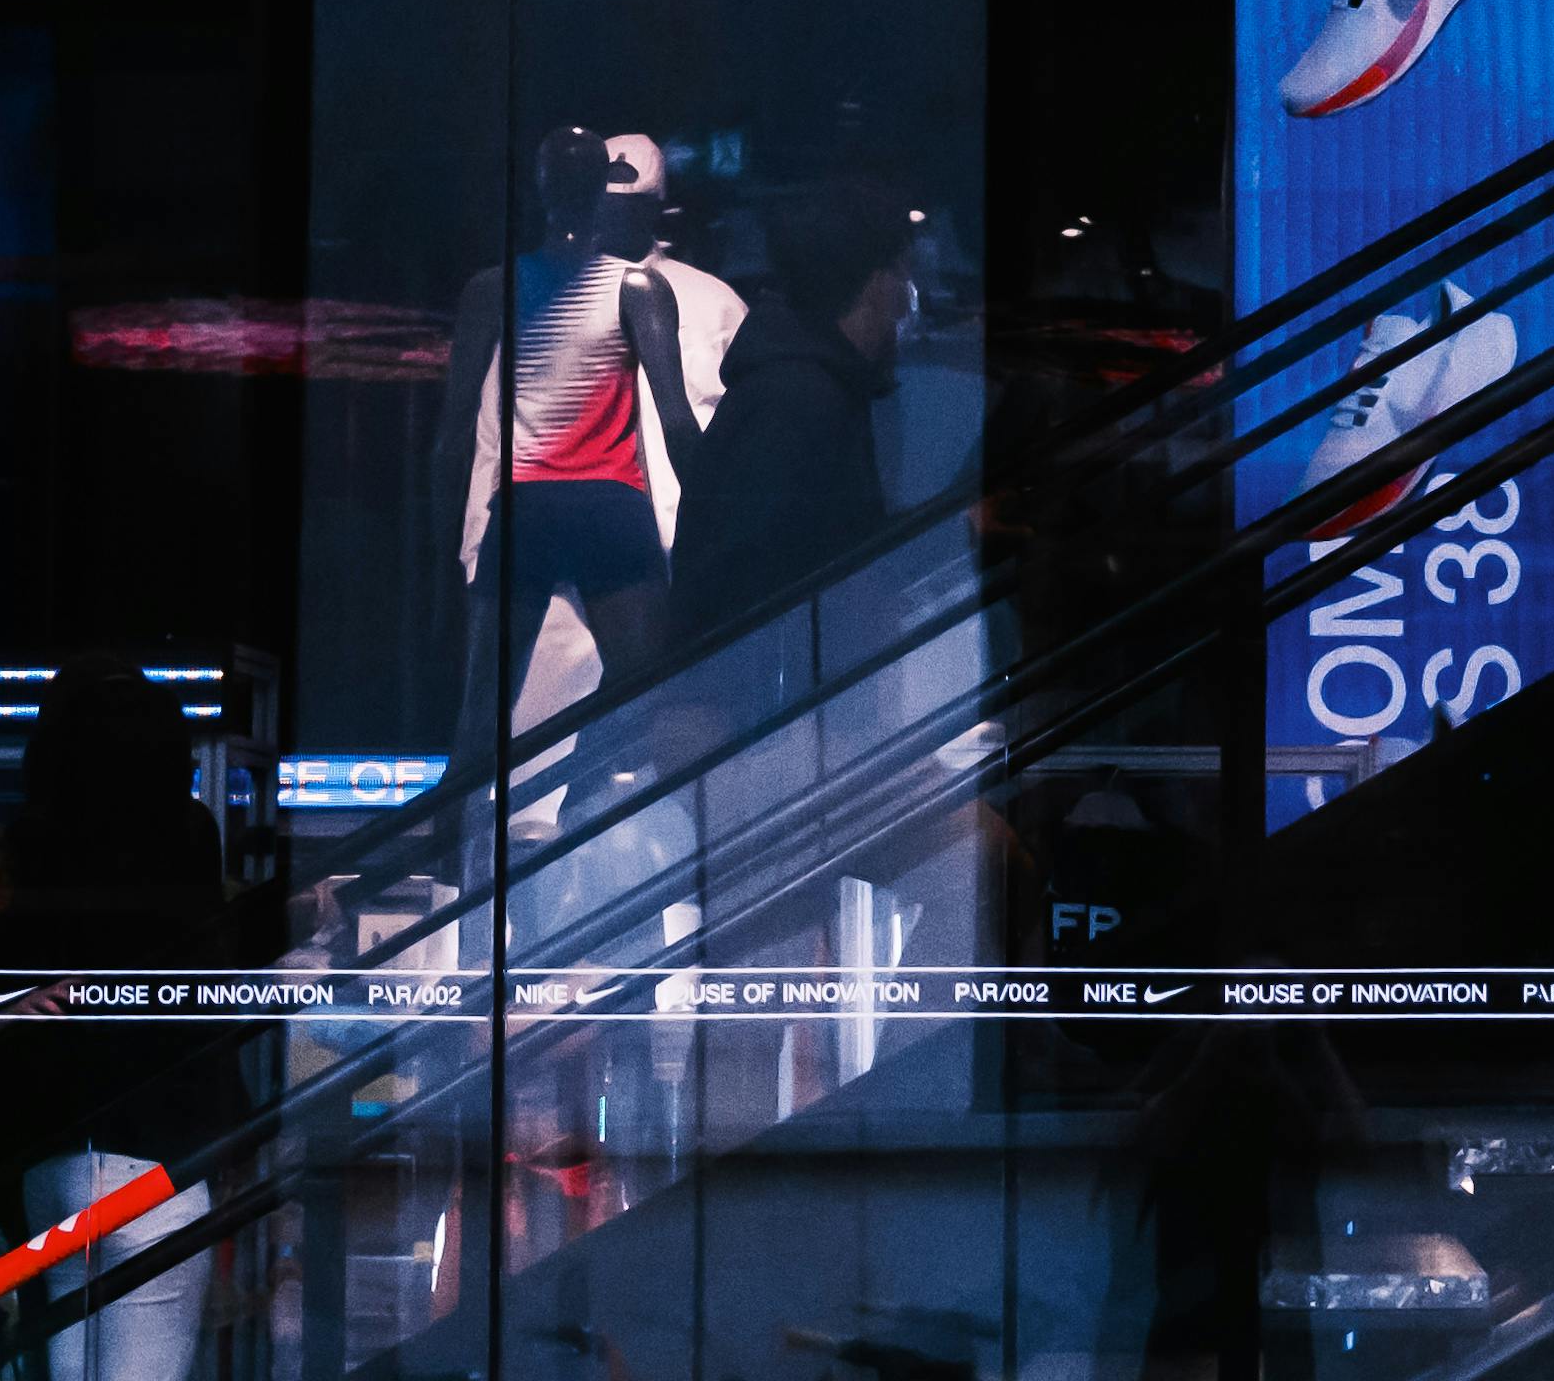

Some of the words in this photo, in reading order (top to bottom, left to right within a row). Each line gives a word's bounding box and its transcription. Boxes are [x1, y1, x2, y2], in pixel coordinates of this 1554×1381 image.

[1307, 535, 1407, 810] OM
[70, 984, 149, 1005] HOUSE
[158, 984, 189, 1005] OF
[198, 984, 333, 1006] INNOVATION
[368, 984, 461, 1006] PAR/002
[515, 983, 567, 1005] NIKE
[743, 982, 774, 1004] OF
[783, 982, 919, 1004] INNOVATION
[955, 982, 1048, 1003] PAR/002
[1084, 983, 1136, 1003] NIKE
[1225, 983, 1304, 1004] HOUSE
[1313, 983, 1343, 1004] OF
[1352, 983, 1487, 1003] INNOVATION
